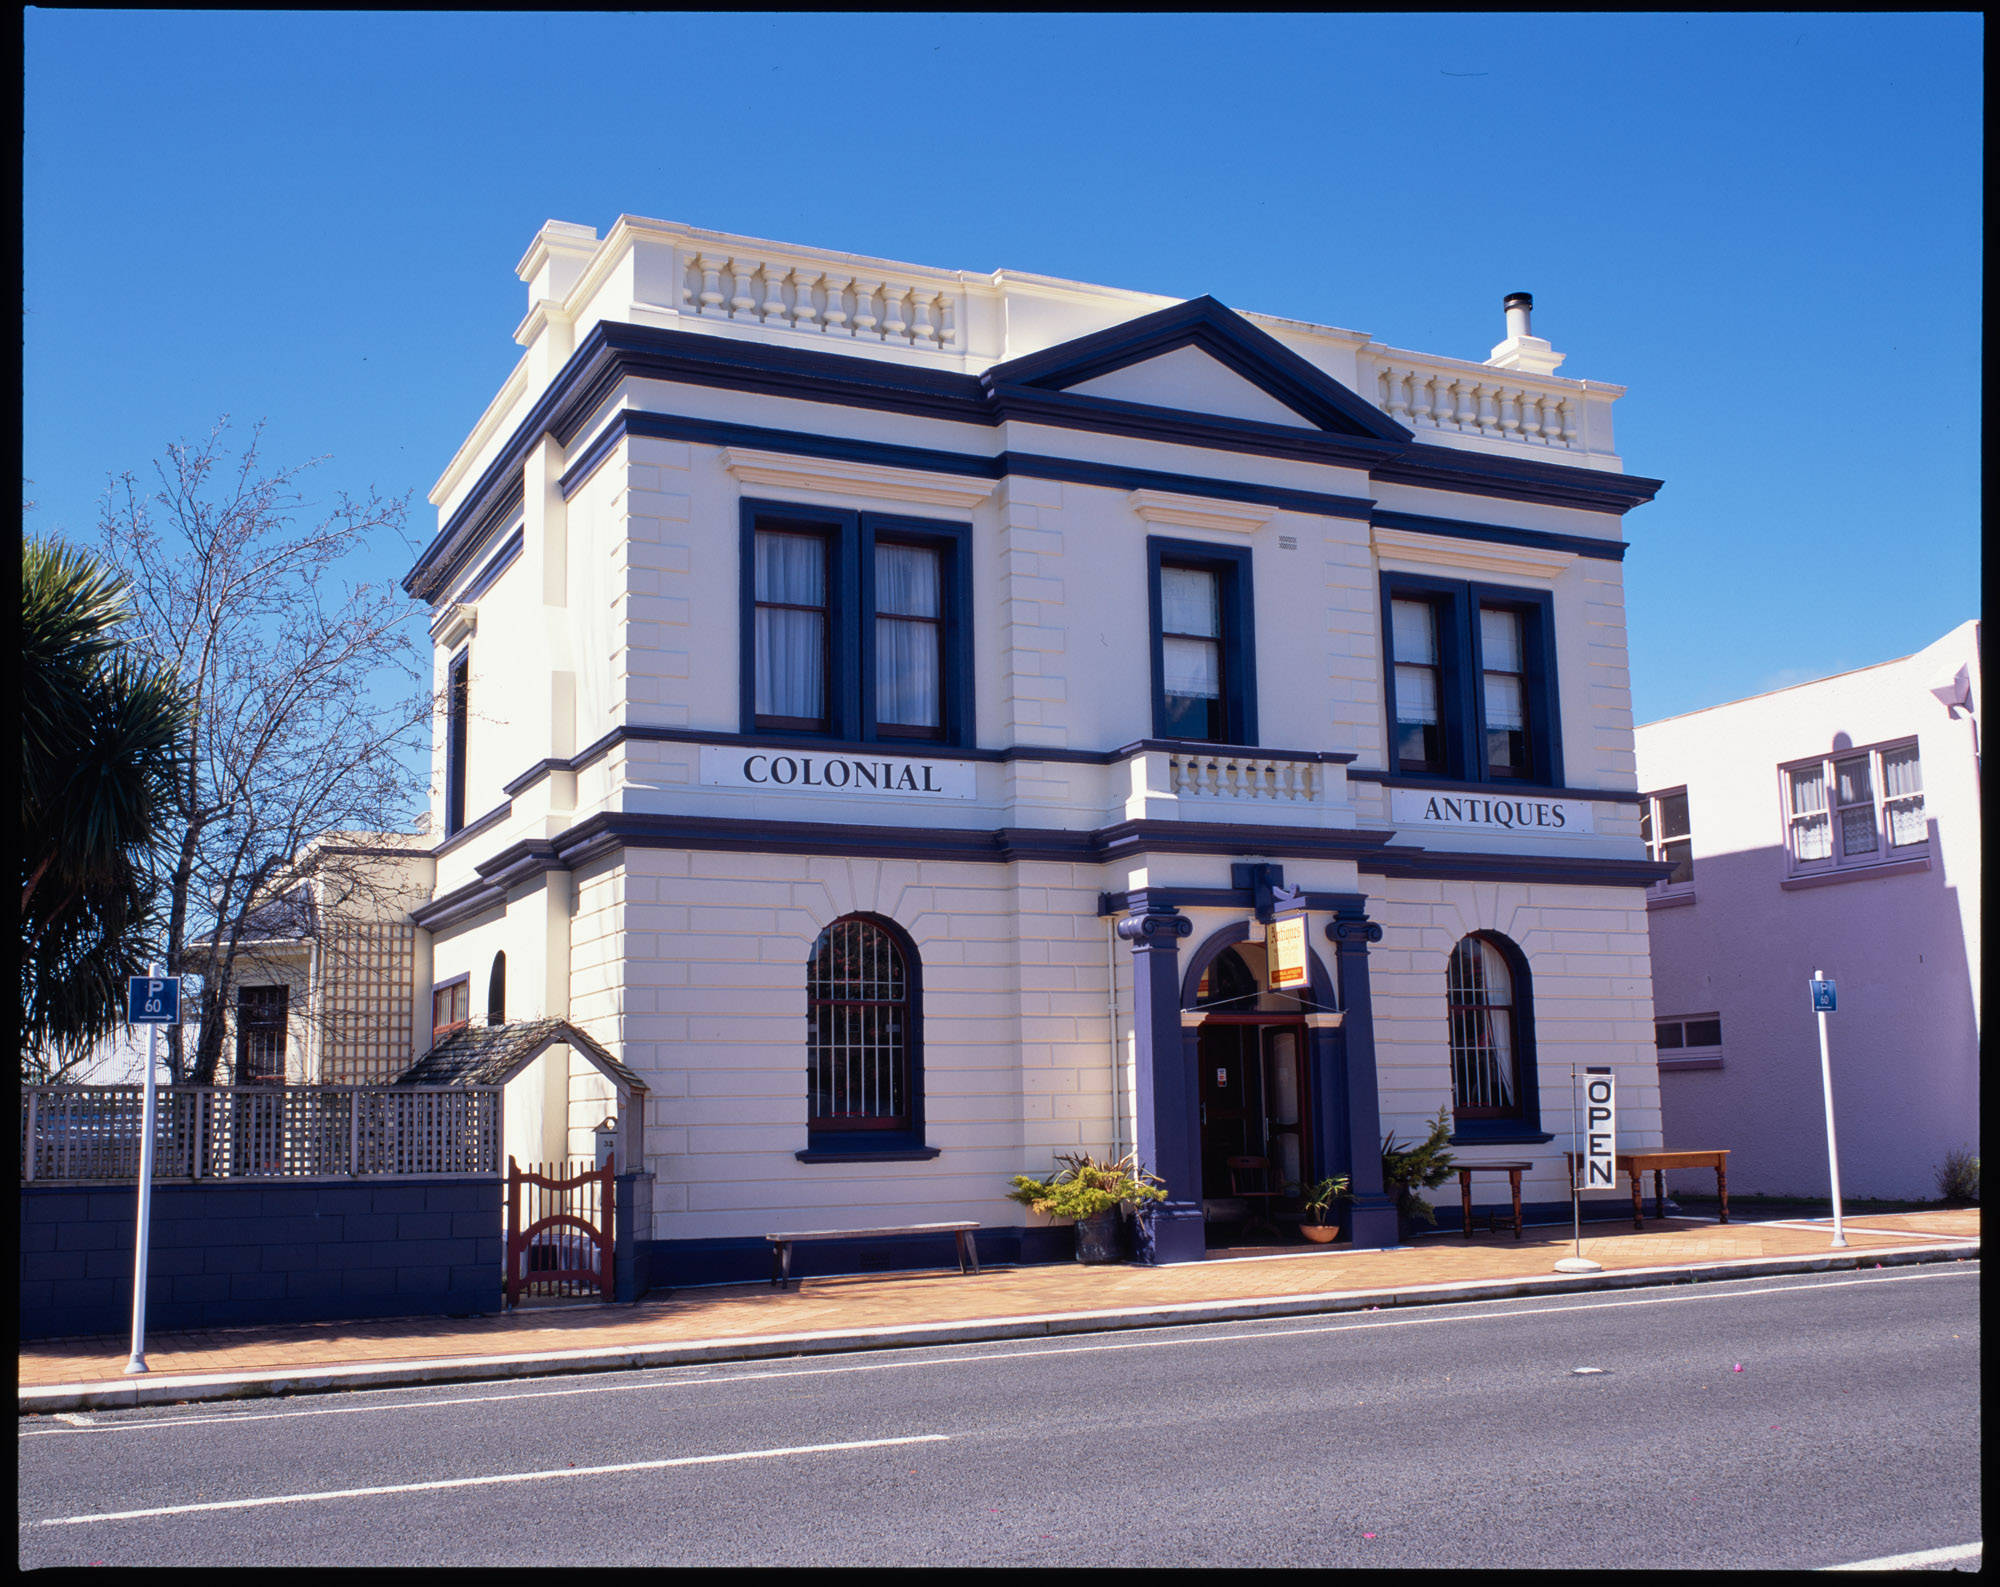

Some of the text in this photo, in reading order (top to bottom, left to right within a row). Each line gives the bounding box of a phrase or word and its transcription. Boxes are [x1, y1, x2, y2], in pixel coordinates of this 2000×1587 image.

[743, 755, 942, 792] COLONIAL
[1424, 797, 1566, 829] ANTIQUES
[149, 980, 164, 998] P
[1820, 982, 1828, 994] P
[145, 999, 161, 1013] 60
[1588, 1081, 1612, 1184] OPEN
